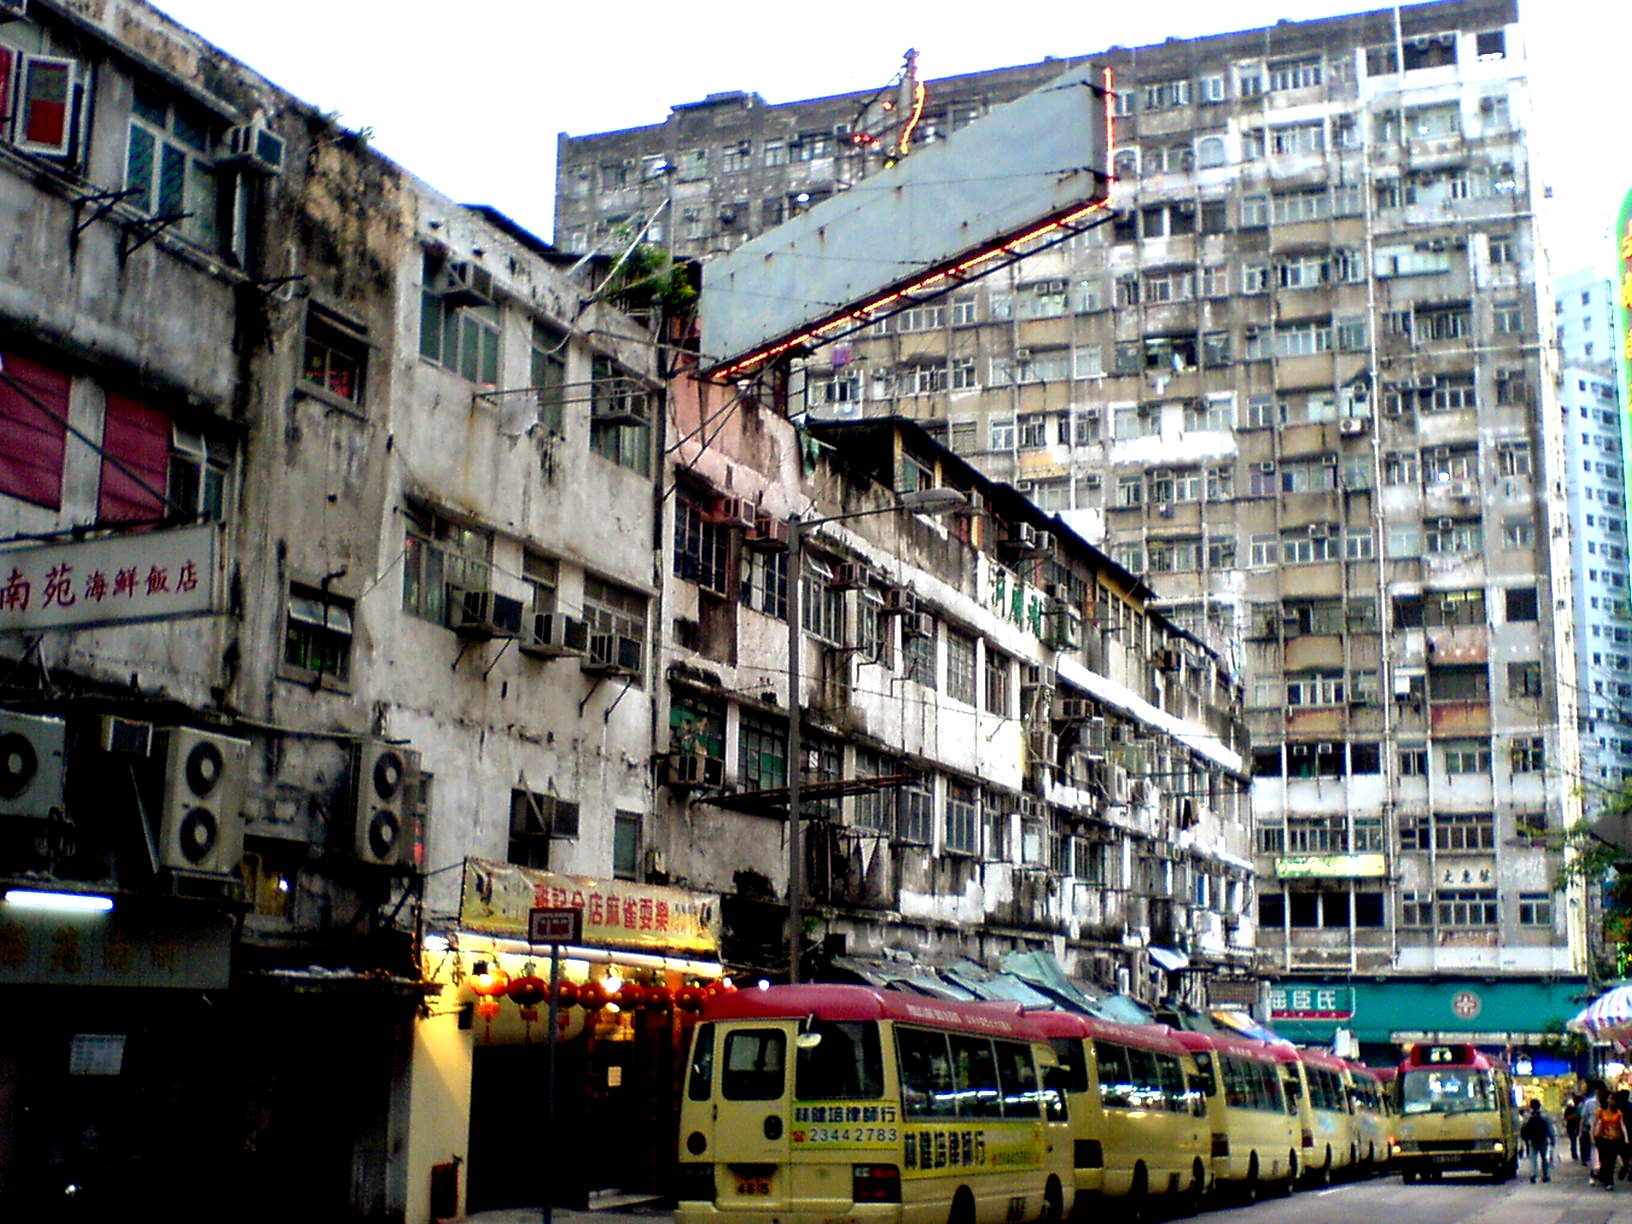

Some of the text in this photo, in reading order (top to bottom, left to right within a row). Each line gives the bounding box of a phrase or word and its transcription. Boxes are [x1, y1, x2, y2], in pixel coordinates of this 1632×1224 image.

[0, 560, 199, 611] 南苑海鮮飯店
[1270, 990, 1336, 1009] 屈臣氏
[809, 1128, 897, 1142] 2344 2783
